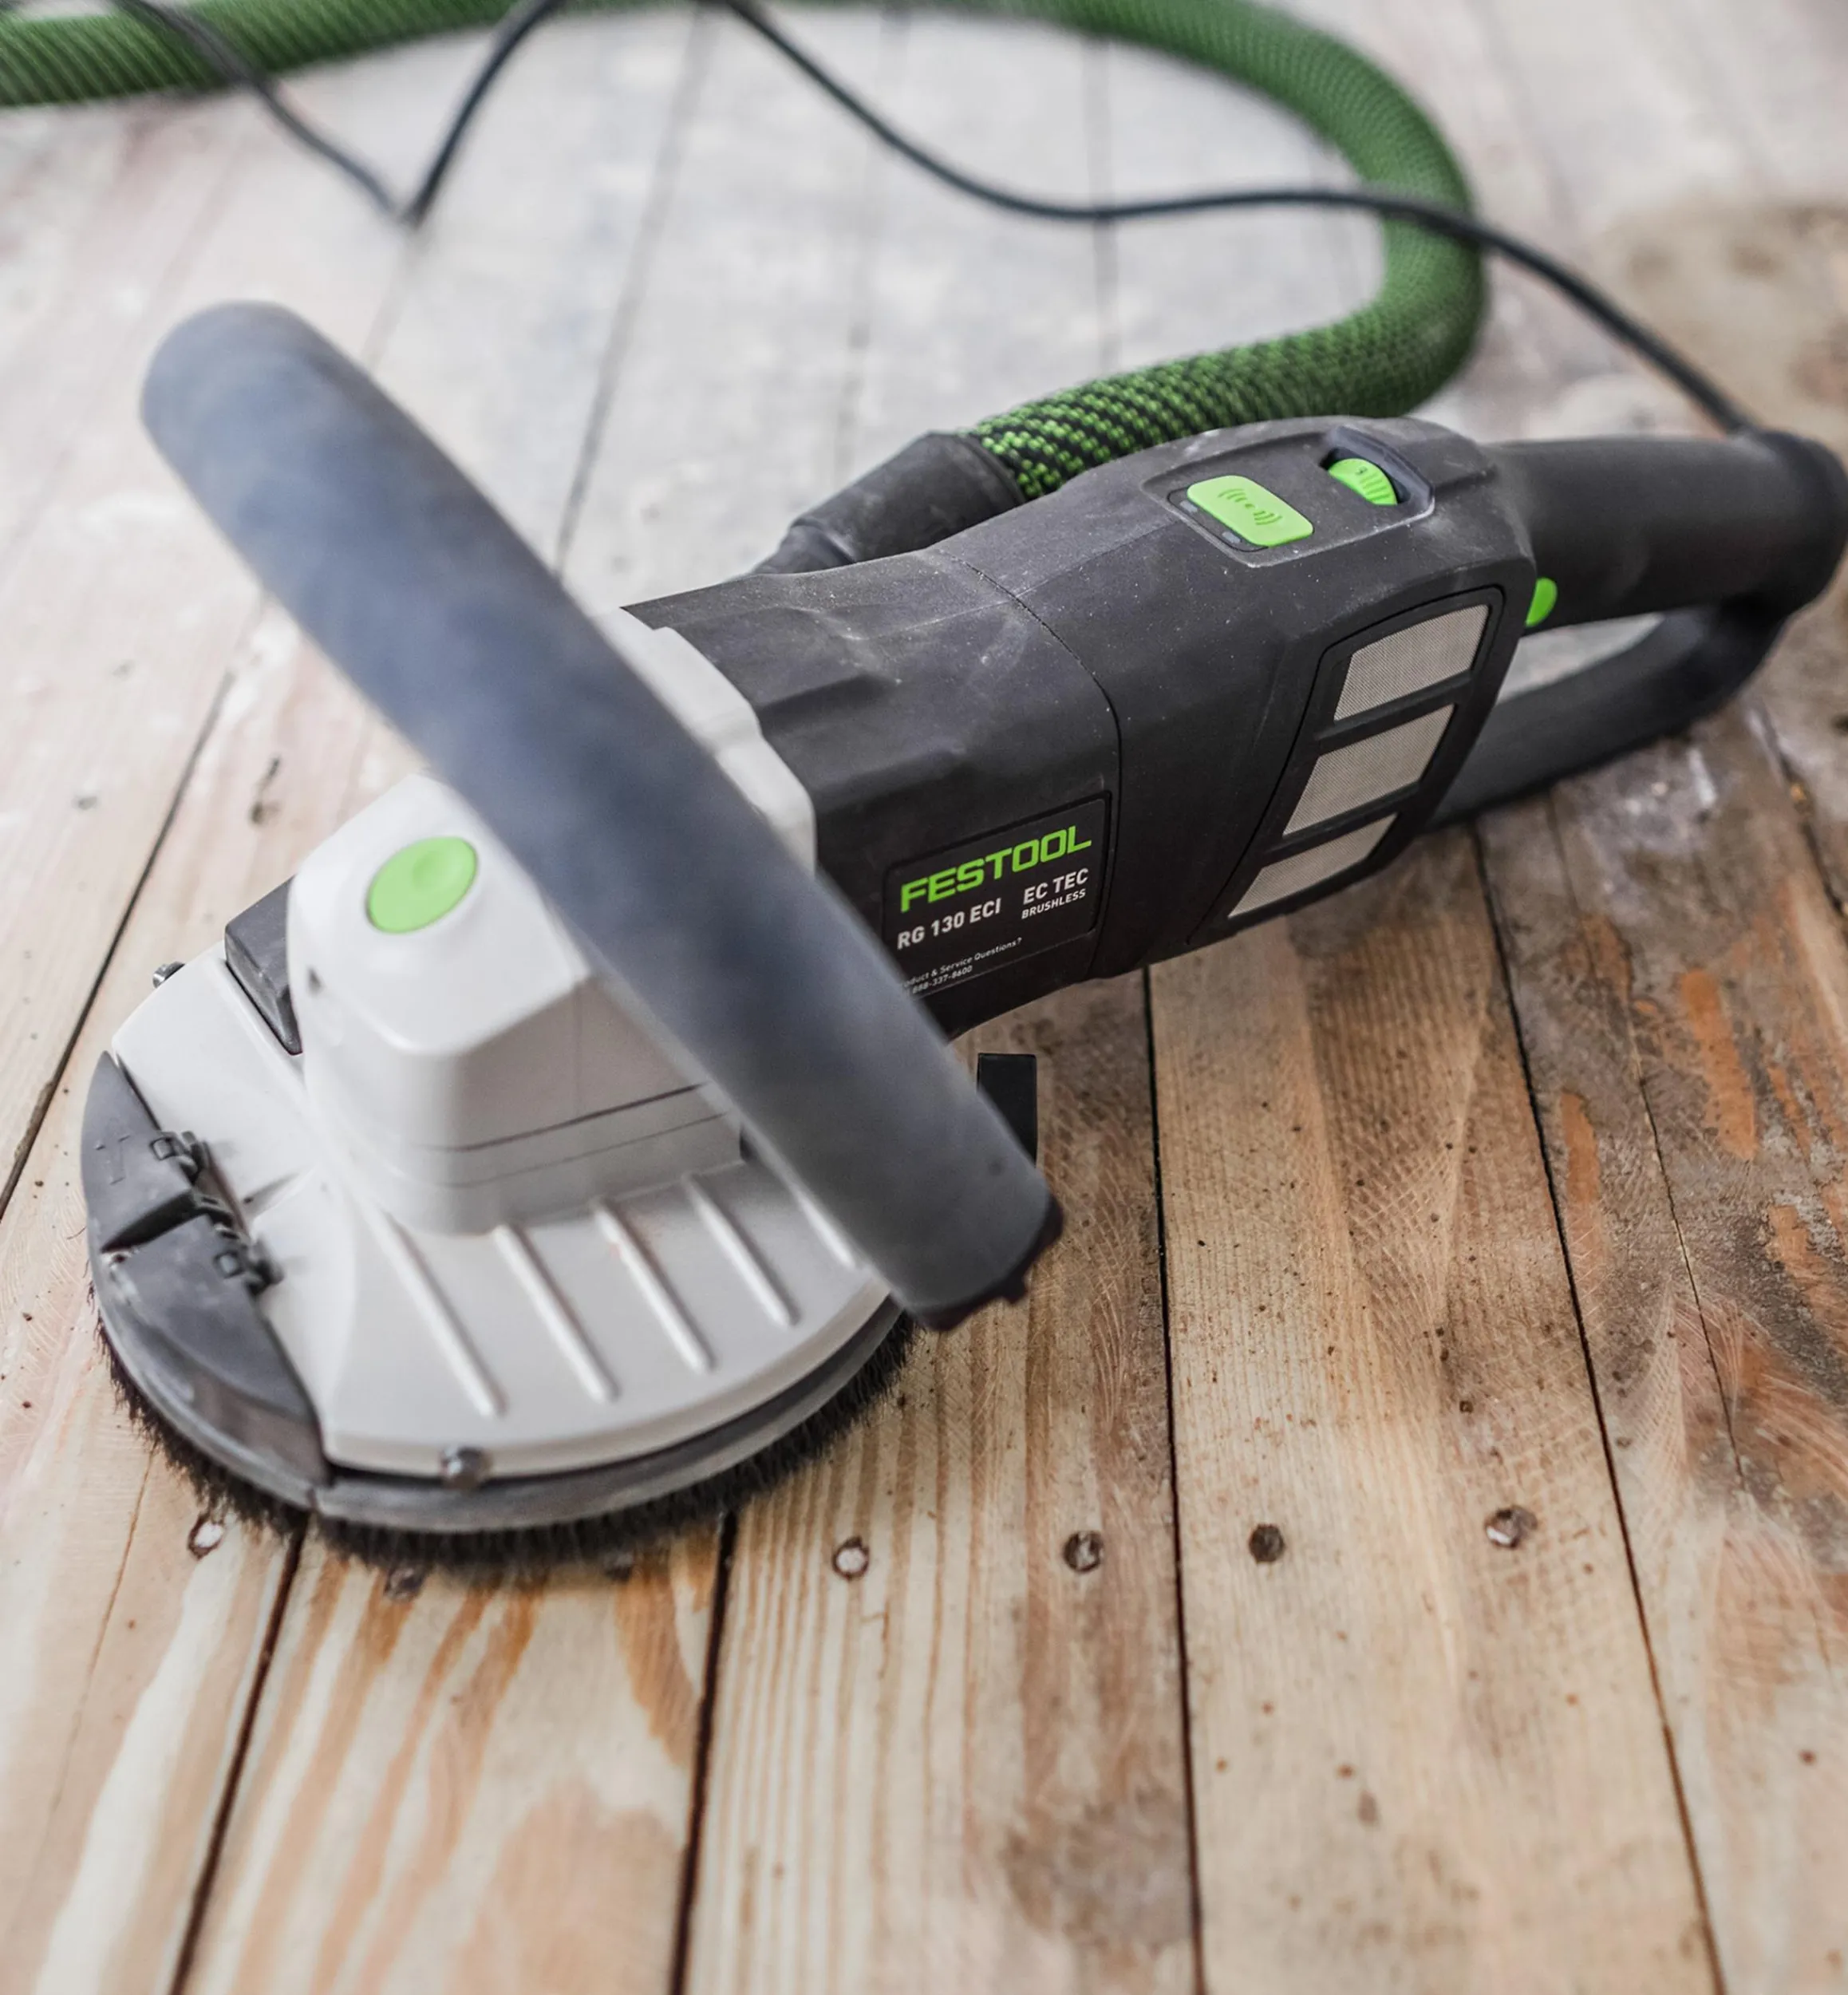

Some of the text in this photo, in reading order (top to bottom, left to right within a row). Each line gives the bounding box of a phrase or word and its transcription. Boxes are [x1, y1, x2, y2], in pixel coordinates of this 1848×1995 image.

[901, 826, 1092, 913] FESTOOL
[1023, 868, 1088, 905] EC TEC
[897, 898, 1001, 950] RG 130 ECI
[1021, 889, 1086, 919] BRUSHLESS
[905, 972, 929, 987] oduct
[940, 958, 972, 974] Service
[974, 937, 1022, 960] Questions?
